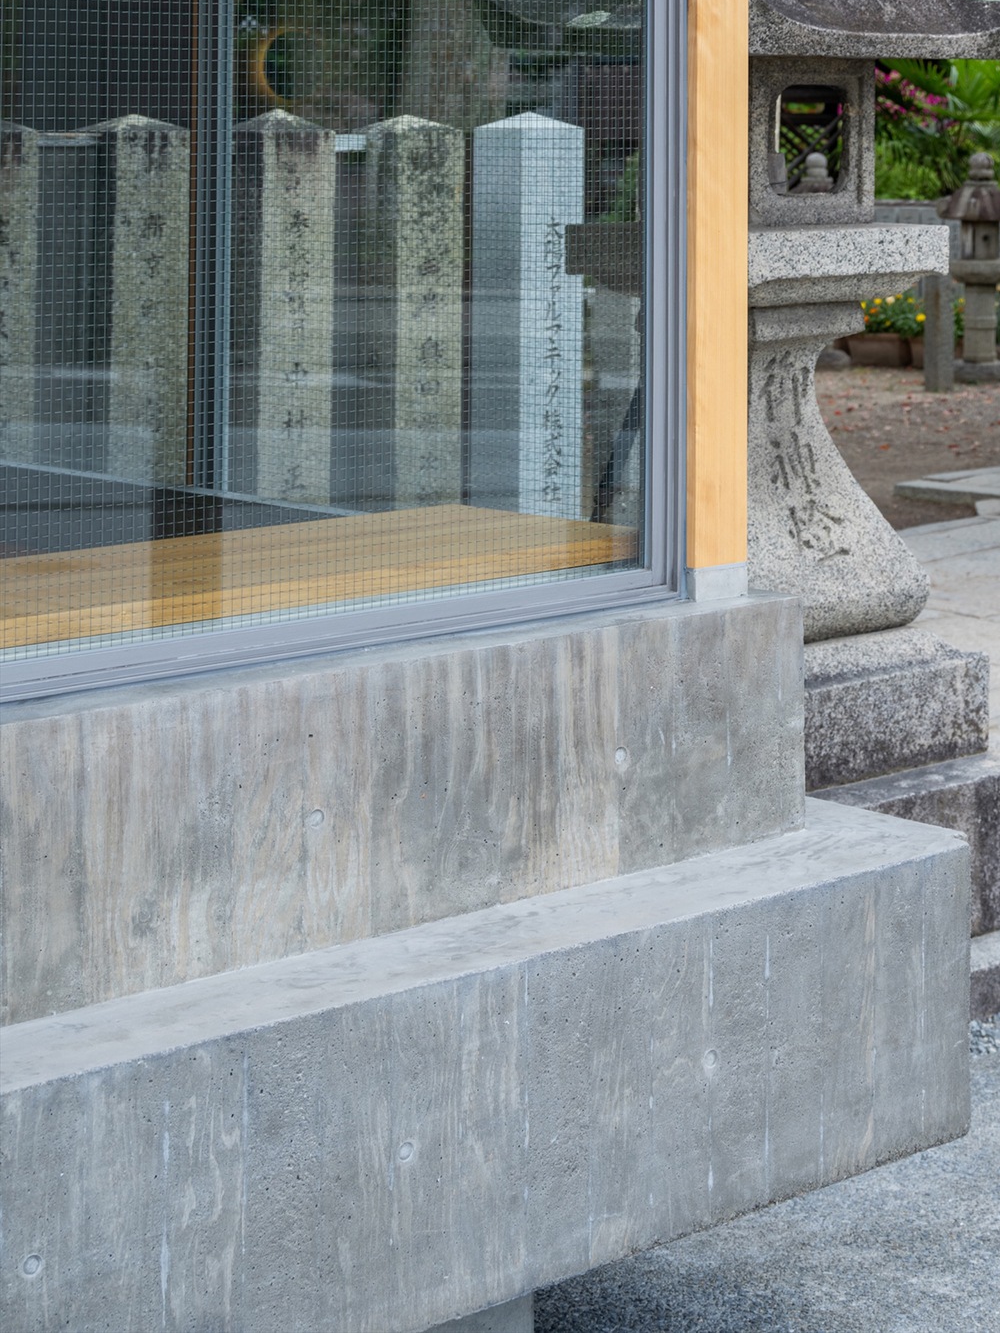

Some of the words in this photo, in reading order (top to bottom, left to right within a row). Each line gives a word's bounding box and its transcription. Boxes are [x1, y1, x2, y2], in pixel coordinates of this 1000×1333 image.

[543, 216, 565, 503] 太陽ファルマテック株式会社
